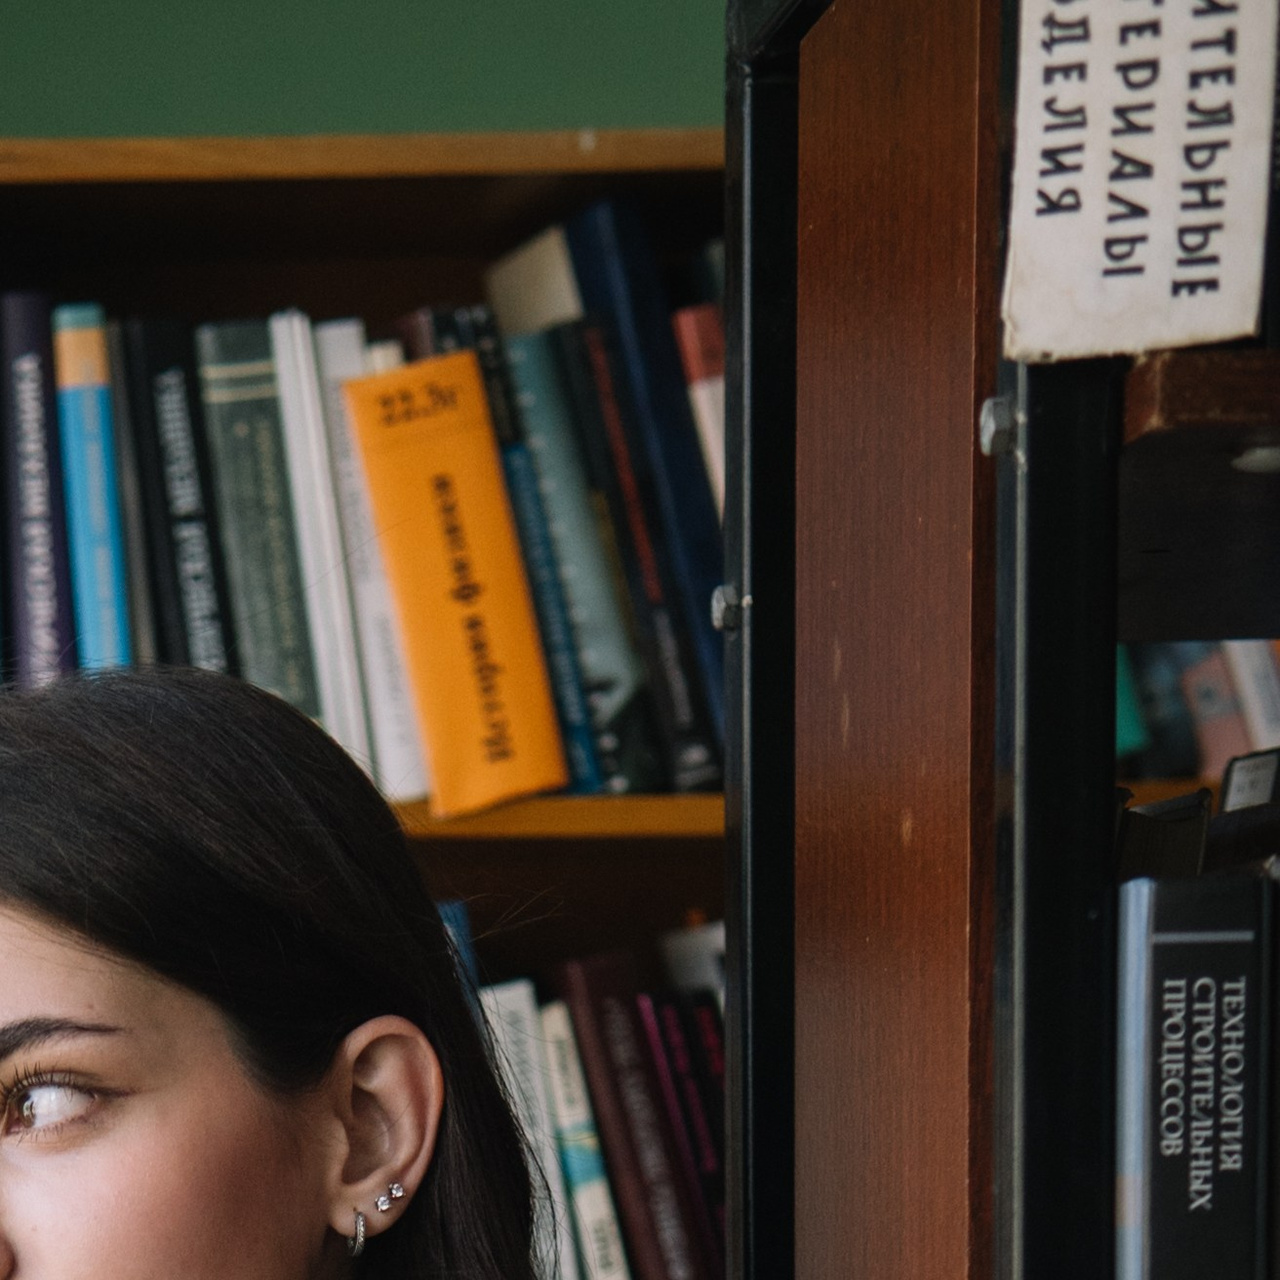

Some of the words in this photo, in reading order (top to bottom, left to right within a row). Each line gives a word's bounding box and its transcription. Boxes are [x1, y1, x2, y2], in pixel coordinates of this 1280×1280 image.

[1035, 0, 1091, 217] ДЕЛИЯ
[1159, 978, 1187, 1157] ПРОЦЕССОВ
[1189, 976, 1217, 1212] СТРОИТЕЛЬНЫХ
[1219, 976, 1247, 1172] ТЕХНОЛОГИЯ
